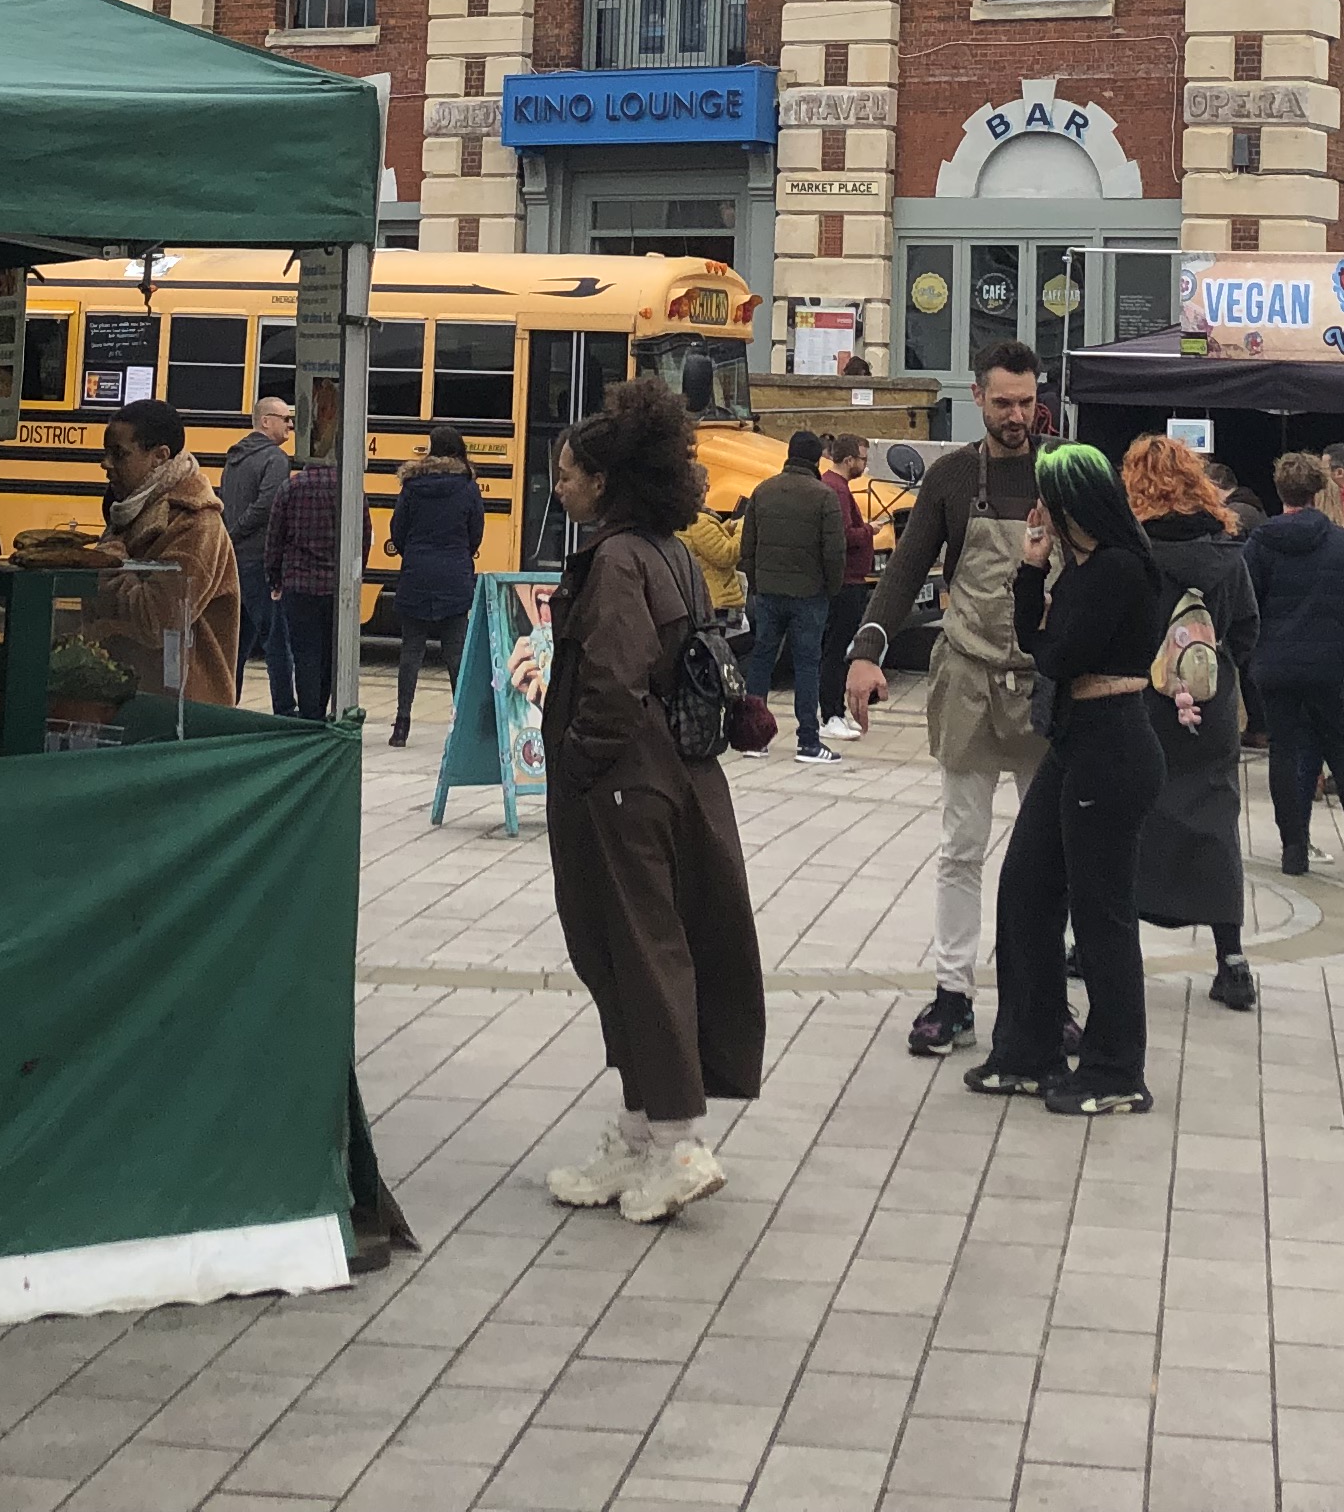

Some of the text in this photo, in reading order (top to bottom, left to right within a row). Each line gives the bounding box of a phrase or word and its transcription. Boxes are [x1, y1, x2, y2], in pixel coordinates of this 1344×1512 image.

[513, 89, 744, 124] KINO LOUNGE
[1189, 86, 1307, 119] OPERA
[986, 102, 1090, 140] BAR
[790, 182, 873, 193] MARKET PLACE
[982, 281, 1007, 300] CAFÉ
[1204, 282, 1312, 324] VEGAN
[19, 425, 88, 445] DISTRICT
[368, 437, 377, 455] 4
